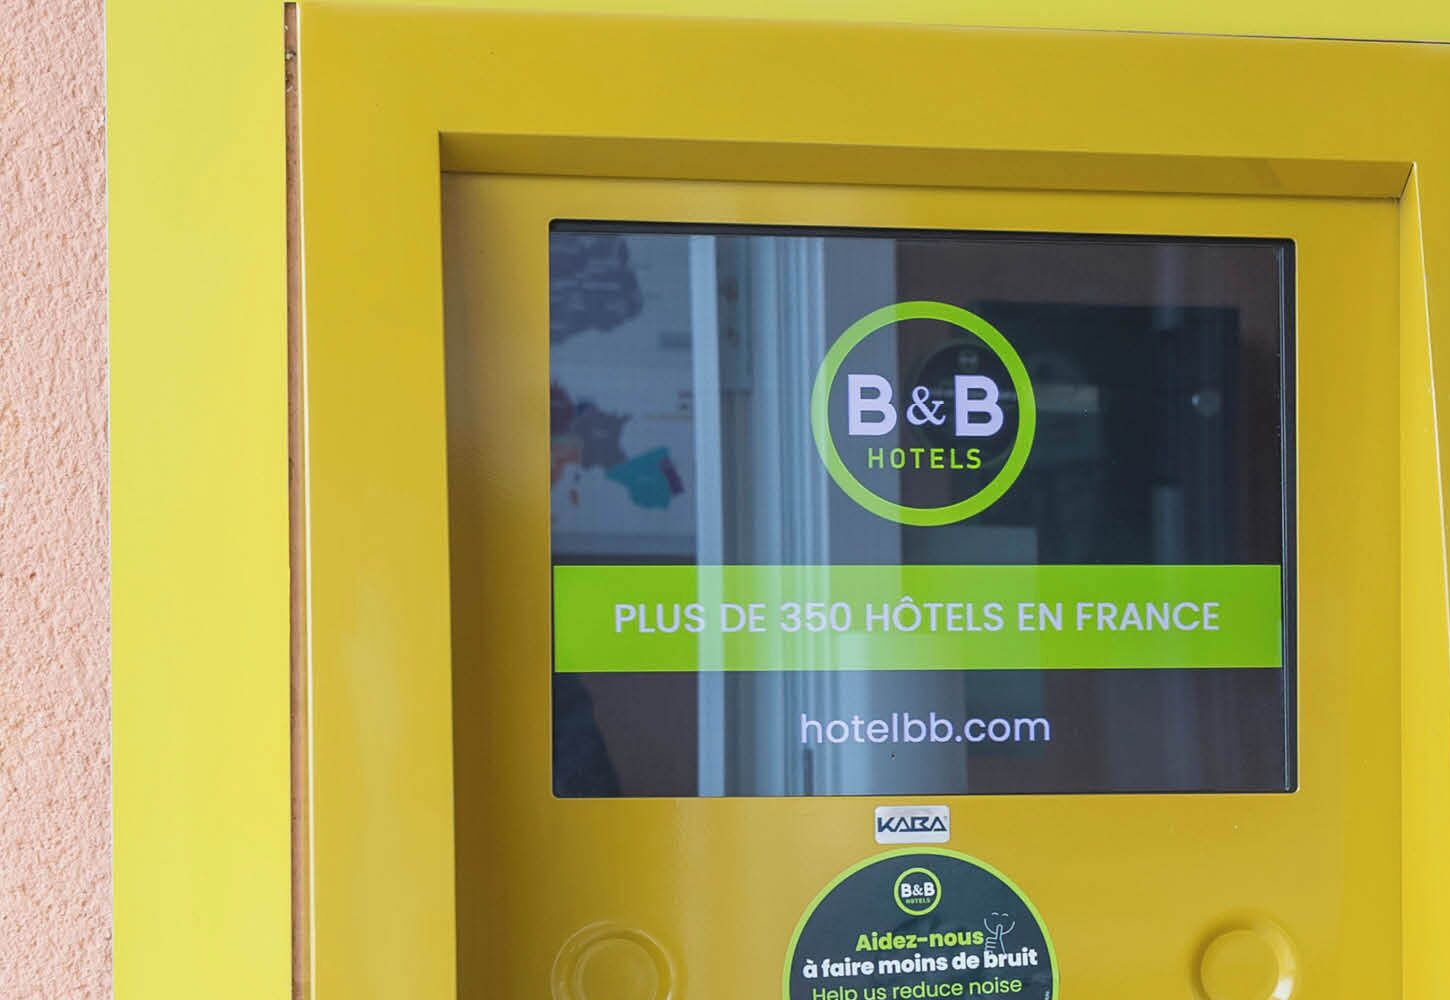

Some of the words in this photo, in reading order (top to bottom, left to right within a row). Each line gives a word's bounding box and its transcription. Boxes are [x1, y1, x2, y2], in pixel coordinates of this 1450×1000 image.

[847, 373, 1005, 437] B&B
[867, 447, 983, 470] HOTELS
[614, 603, 706, 634] PLUS
[720, 603, 767, 634] DE
[780, 602, 852, 633] 350
[865, 595, 1004, 633] HÔTELS
[1019, 602, 1063, 632] EN
[1076, 601, 1220, 632] FRANCE
[800, 713, 1052, 744] hotelbb.com
[877, 816, 947, 833] KABA
[901, 882, 936, 898] B&B
[905, 897, 931, 905] HOTELS
[856, 931, 985, 951] Aidez-nous
[803, 959, 818, 979] à
[821, 957, 875, 977] faire
[878, 953, 948, 975] moins
[952, 951, 980, 970] de
[983, 947, 1038, 969] bruit
[864, 986, 887, 1000] us
[892, 981, 964, 1000] reduce
[969, 977, 1023, 995] noise
